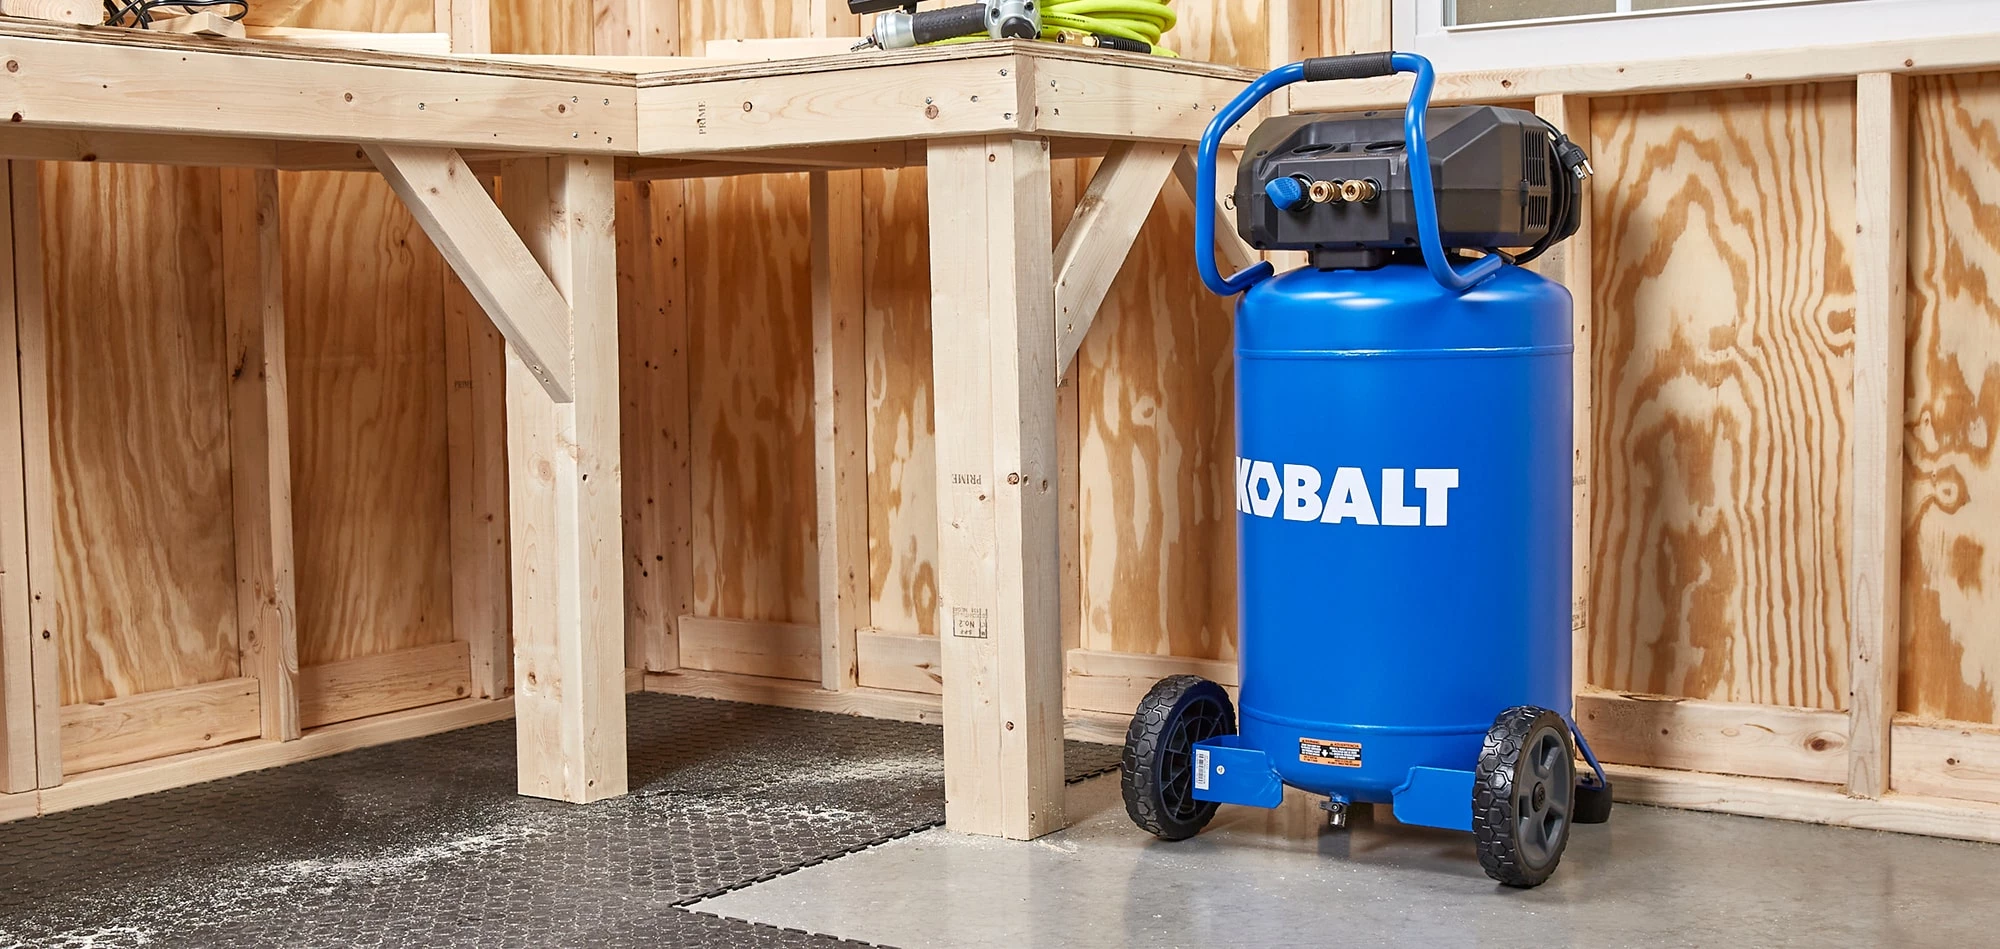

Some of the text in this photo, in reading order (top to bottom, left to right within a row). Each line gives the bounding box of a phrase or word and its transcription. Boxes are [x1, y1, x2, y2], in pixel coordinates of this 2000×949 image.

[698, 101, 706, 134] PRIME
[951, 473, 982, 485] PRIME
[1235, 456, 1459, 527] KOBALT
